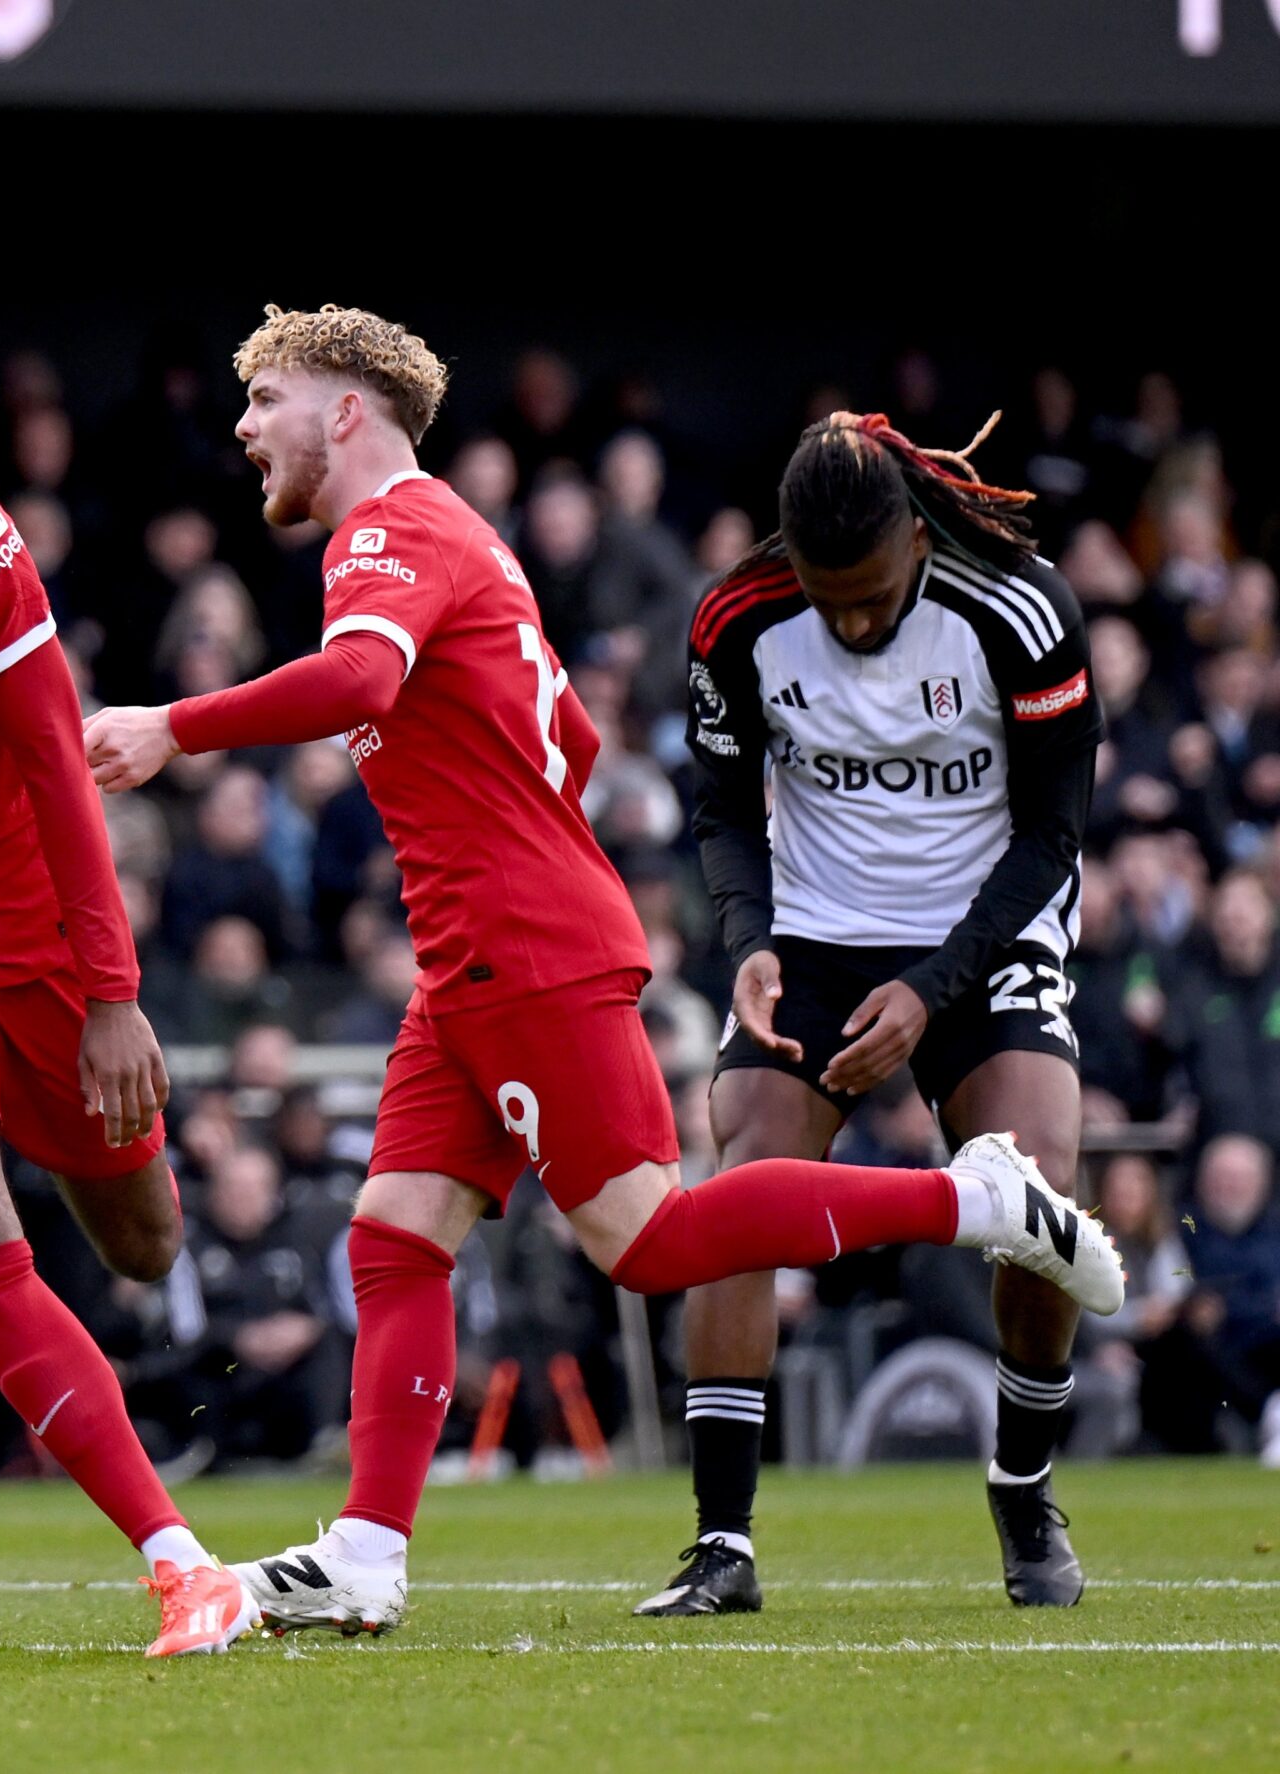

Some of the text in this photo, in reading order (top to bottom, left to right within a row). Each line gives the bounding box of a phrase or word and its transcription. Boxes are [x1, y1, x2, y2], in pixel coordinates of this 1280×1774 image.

[324, 557, 416, 592] Expedia
[813, 746, 993, 798] SBOTOP
[497, 1080, 540, 1163] 9
